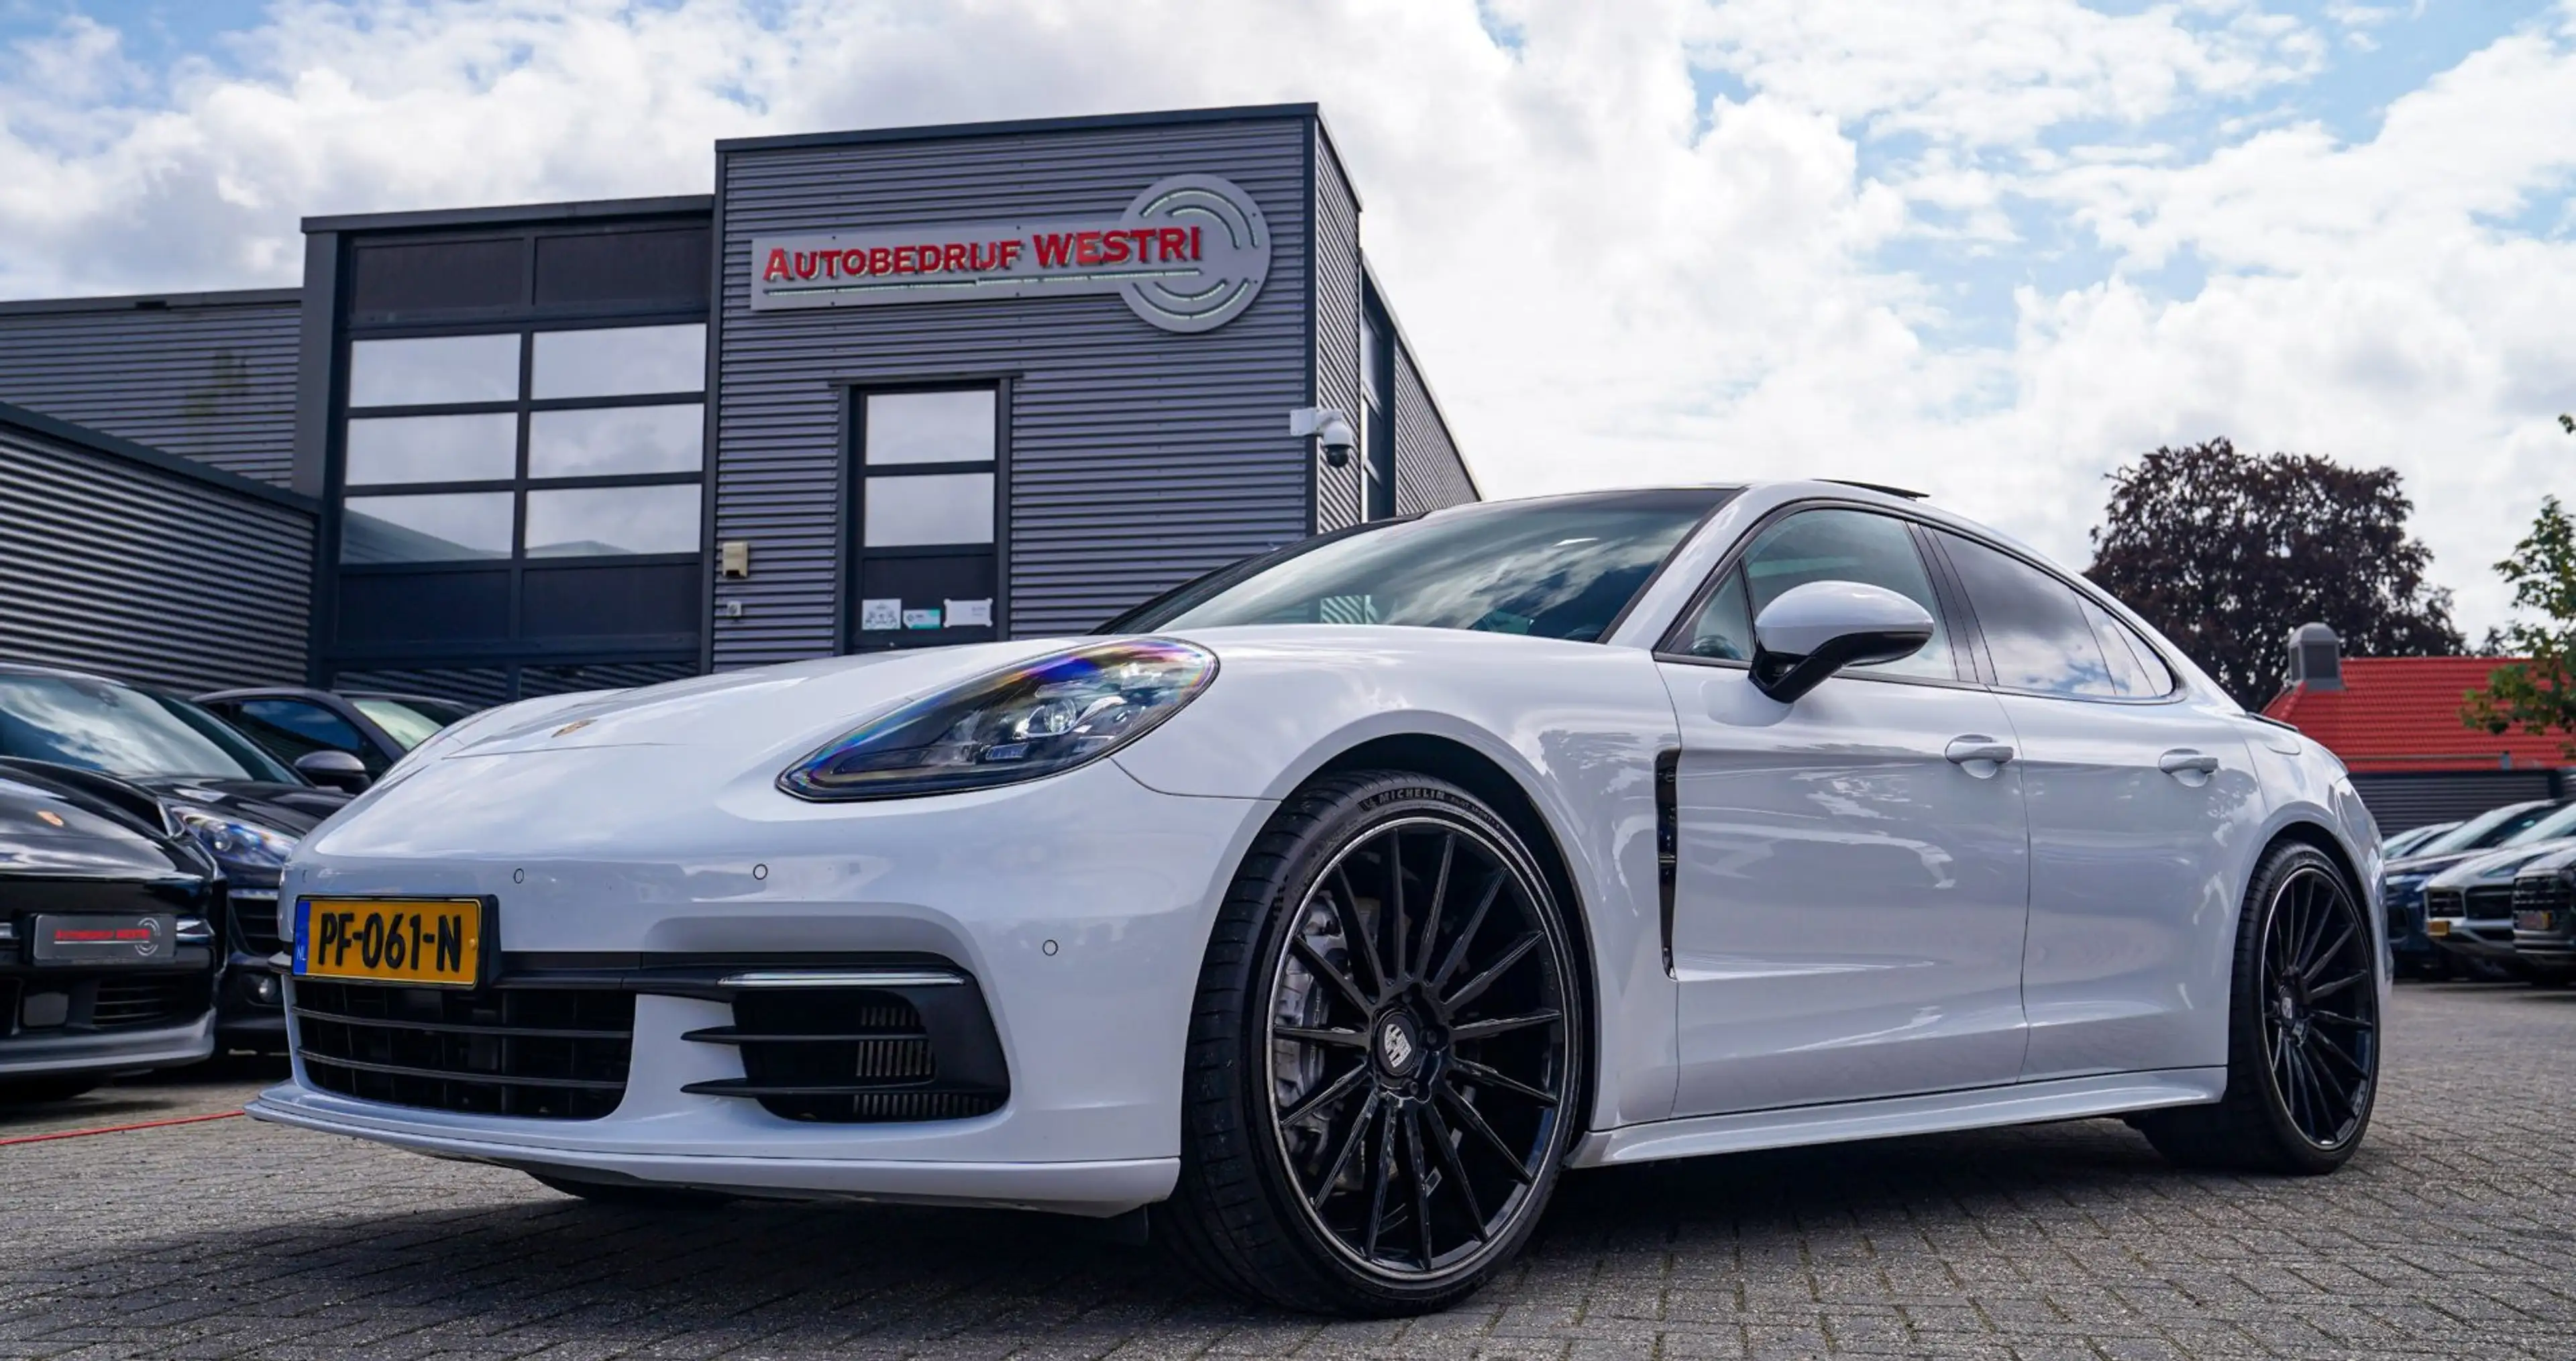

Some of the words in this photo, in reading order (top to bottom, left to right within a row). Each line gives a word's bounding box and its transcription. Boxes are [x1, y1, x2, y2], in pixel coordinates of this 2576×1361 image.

[763, 238, 1022, 281] AUTOBEDRIJF
[1033, 226, 1202, 268] WESTRI
[1379, 788, 1445, 804] MICHELIN
[297, 944, 307, 961] NL
[318, 912, 462, 973] PF-061-N
